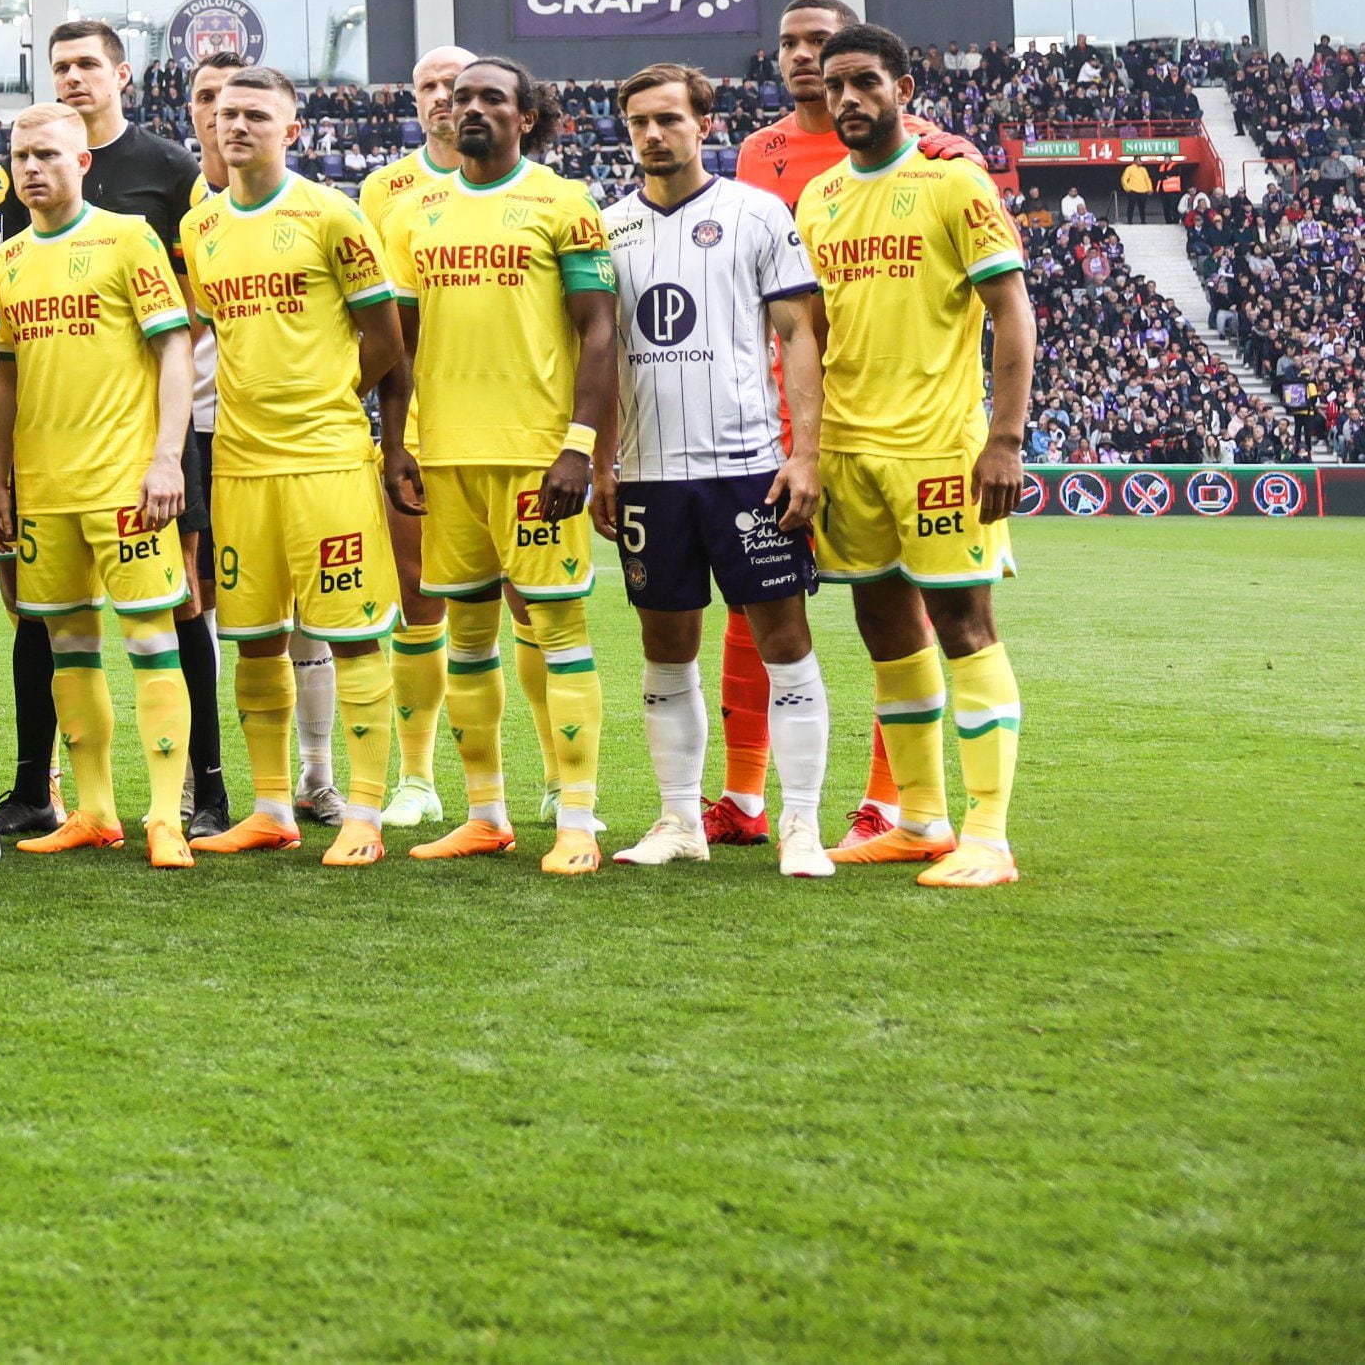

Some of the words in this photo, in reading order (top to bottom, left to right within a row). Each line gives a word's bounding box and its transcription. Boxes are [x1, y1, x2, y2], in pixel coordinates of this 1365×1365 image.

[1088, 143, 1112, 160] 14
[1126, 140, 1176, 152] SORTIE
[390, 174, 415, 191] AFD
[897, 171, 946, 180] PROGINOV
[199, 213, 219, 235] AFD
[607, 218, 644, 241] etway
[414, 244, 531, 275] SYNERGIE
[818, 235, 923, 269] SYNERGIE
[497, 273, 524, 287] CDI
[889, 265, 915, 278] CDI
[204, 272, 307, 306] SYNERGIE
[4, 294, 100, 329] SYNERGIE
[276, 300, 304, 315] CDI
[69, 323, 95, 336] CDI
[628, 350, 714, 366] PROMOTION
[924, 479, 962, 507] ZE
[752, 506, 777, 525] Sud
[918, 511, 964, 538] bet
[517, 521, 561, 547] bet
[622, 504, 647, 553] 5
[758, 525, 778, 538] de
[120, 535, 161, 564] bet
[326, 536, 360, 565] ZE
[739, 531, 794, 554] France
[321, 566, 363, 594] bet
[762, 575, 792, 587] CRAFT
